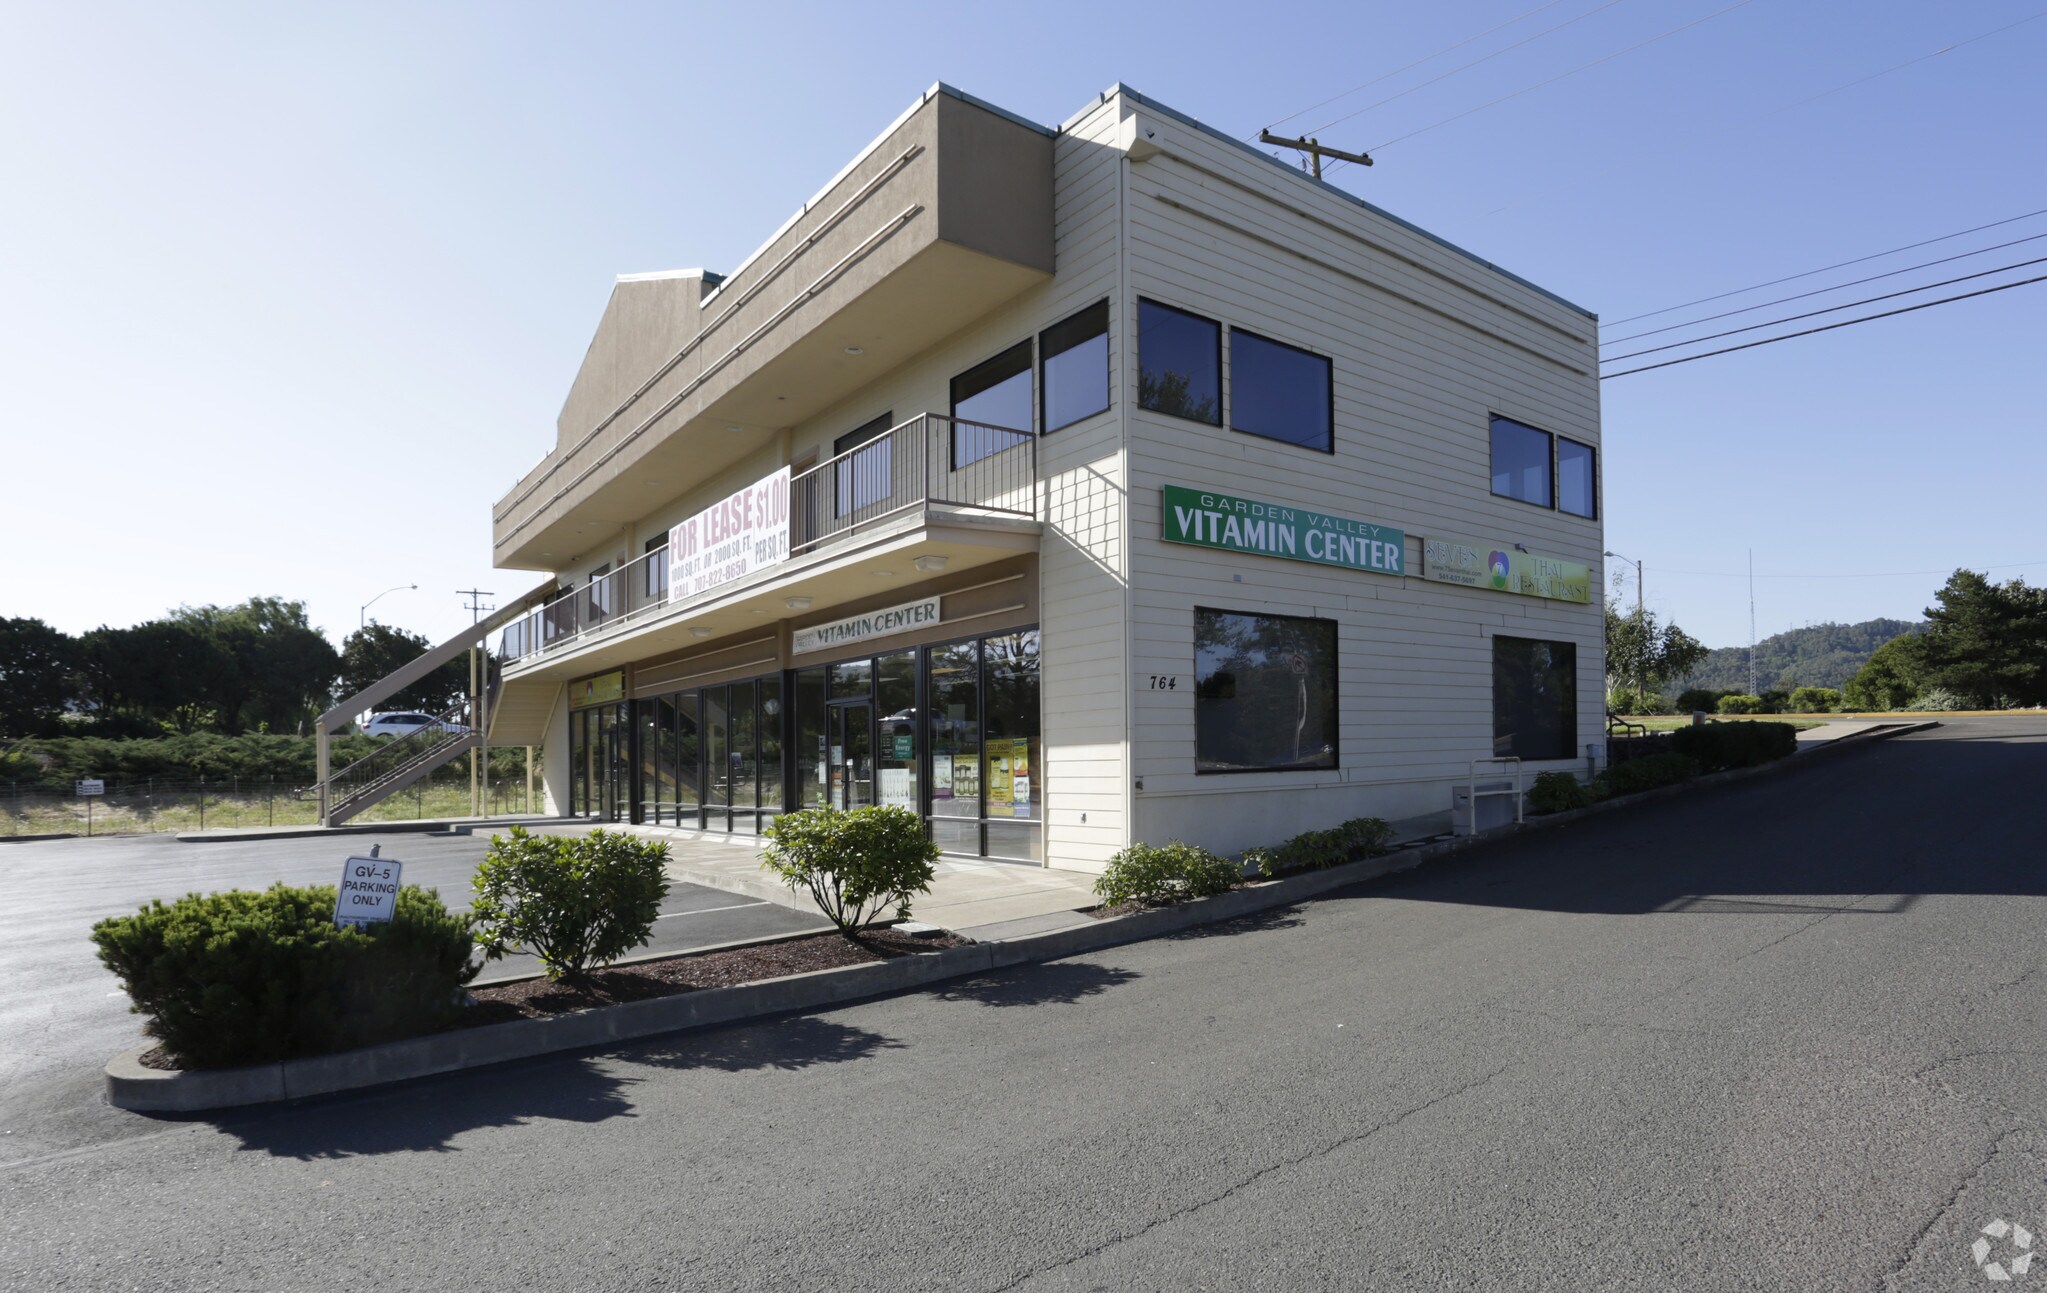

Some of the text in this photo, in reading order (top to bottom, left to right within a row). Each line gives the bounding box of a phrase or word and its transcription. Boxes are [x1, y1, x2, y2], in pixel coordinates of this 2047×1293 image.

[670, 474, 788, 565] FOR LEASE $1.00
[1201, 494, 1380, 537] GARDEN VALLEY
[755, 538, 767, 566] PER
[1174, 505, 1399, 572] VITAMIN CENTER
[704, 552, 712, 569] OR
[714, 543, 731, 565] 2000
[1531, 559, 1562, 580] THAI
[673, 558, 747, 600] CALL 707-822-8650
[1512, 574, 1588, 601] RESTAURANT
[817, 603, 935, 643] VITAMIN CENTER
[1150, 675, 1176, 690] 764
[355, 866, 391, 880] GV-5
[344, 880, 395, 894] PARKING
[352, 894, 383, 906] ONLY
